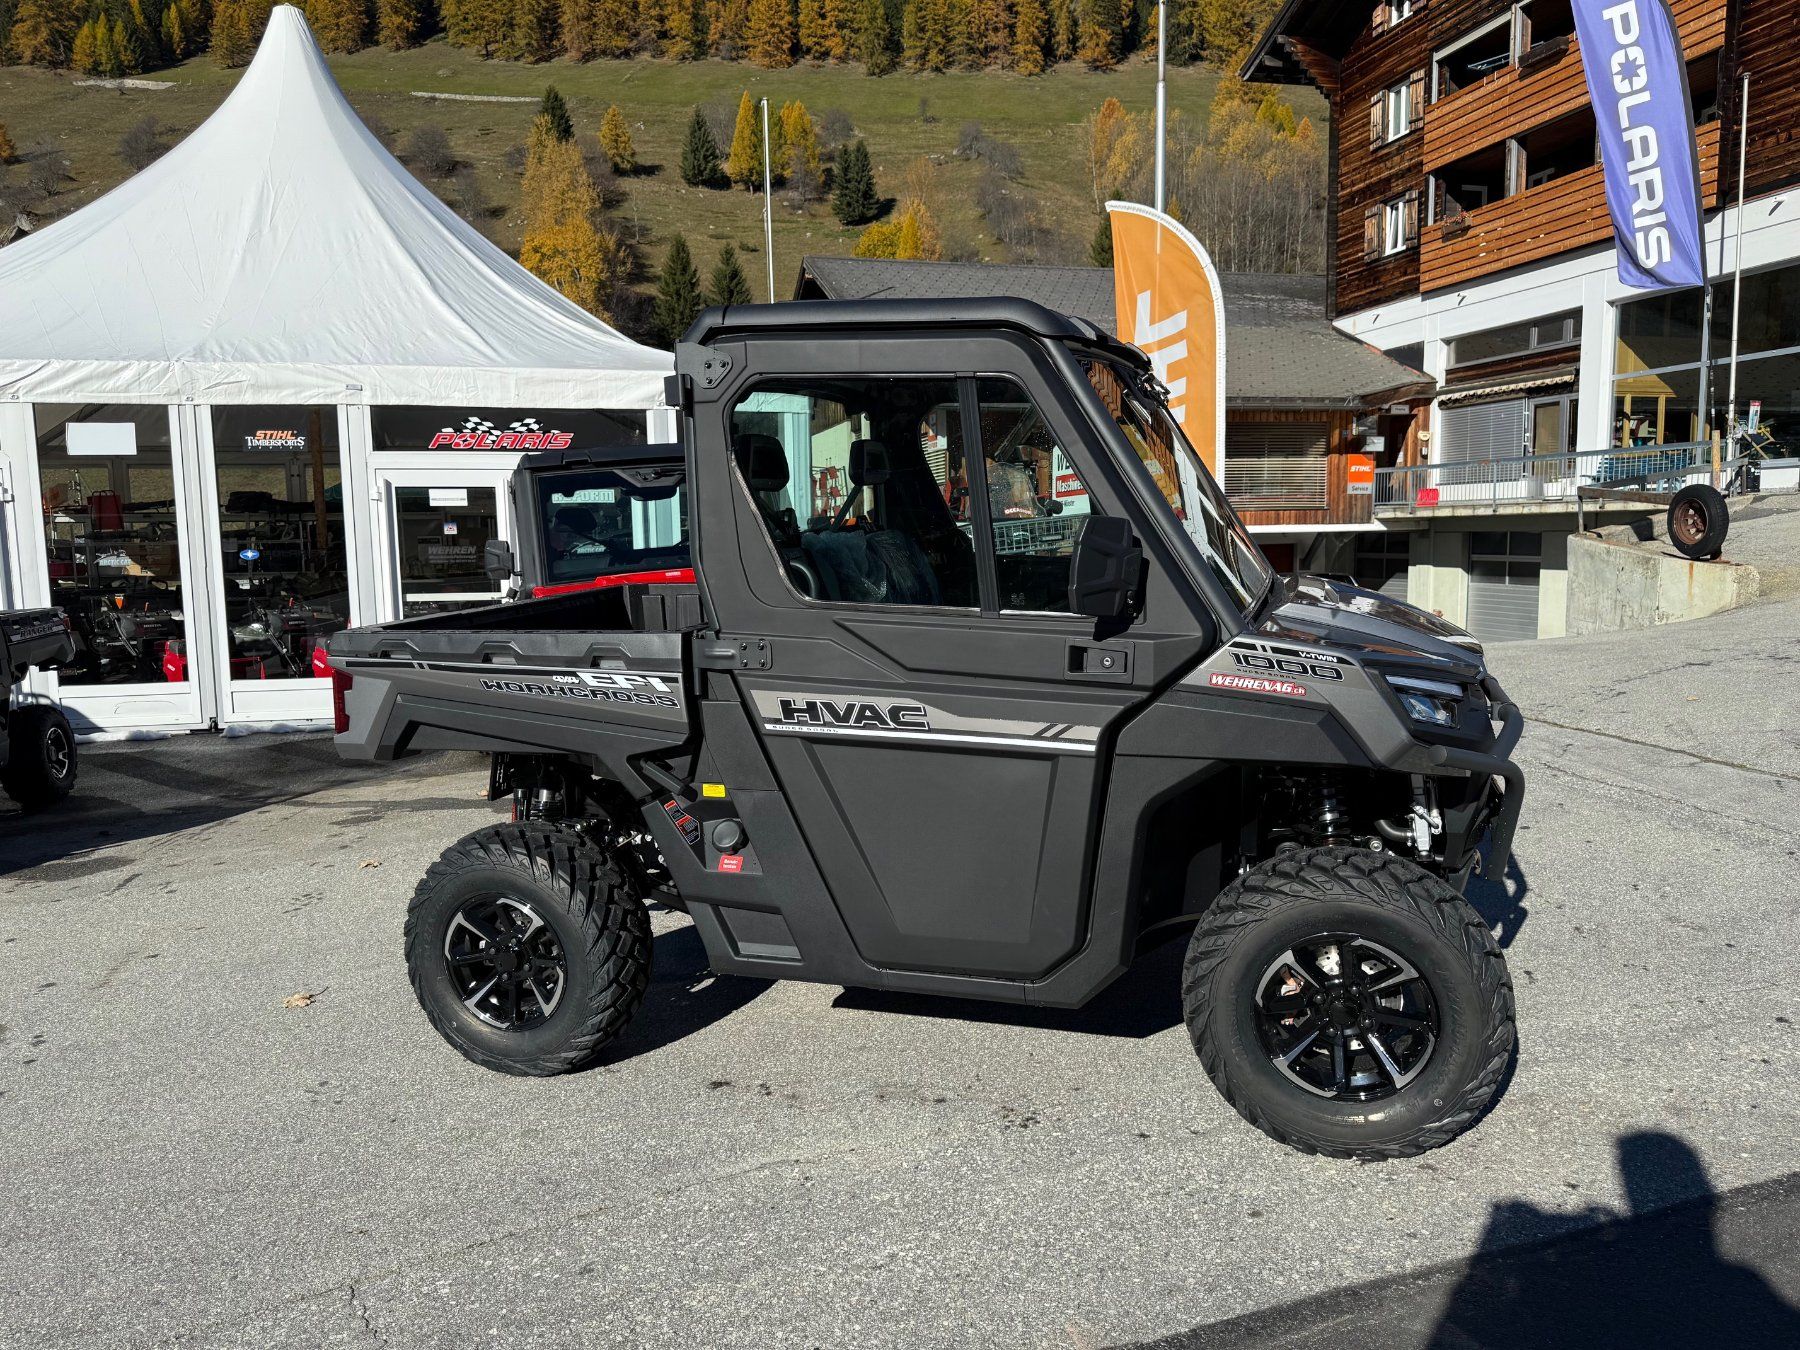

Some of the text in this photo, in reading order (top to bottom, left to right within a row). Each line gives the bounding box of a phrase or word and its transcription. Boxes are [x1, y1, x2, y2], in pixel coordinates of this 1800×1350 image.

[1602, 0, 1672, 269] POLARIS
[255, 430, 296, 440] STIHL
[428, 432, 574, 449] POLARIS
[1350, 465, 1372, 473] STIHL
[428, 545, 477, 555] WEHREN
[1229, 651, 1345, 682] 1000
[1299, 651, 1338, 663] V-TWIN
[576, 671, 673, 694] EFI
[1210, 674, 1305, 695] WEHRENAG.ch
[776, 697, 931, 731] HVAC
